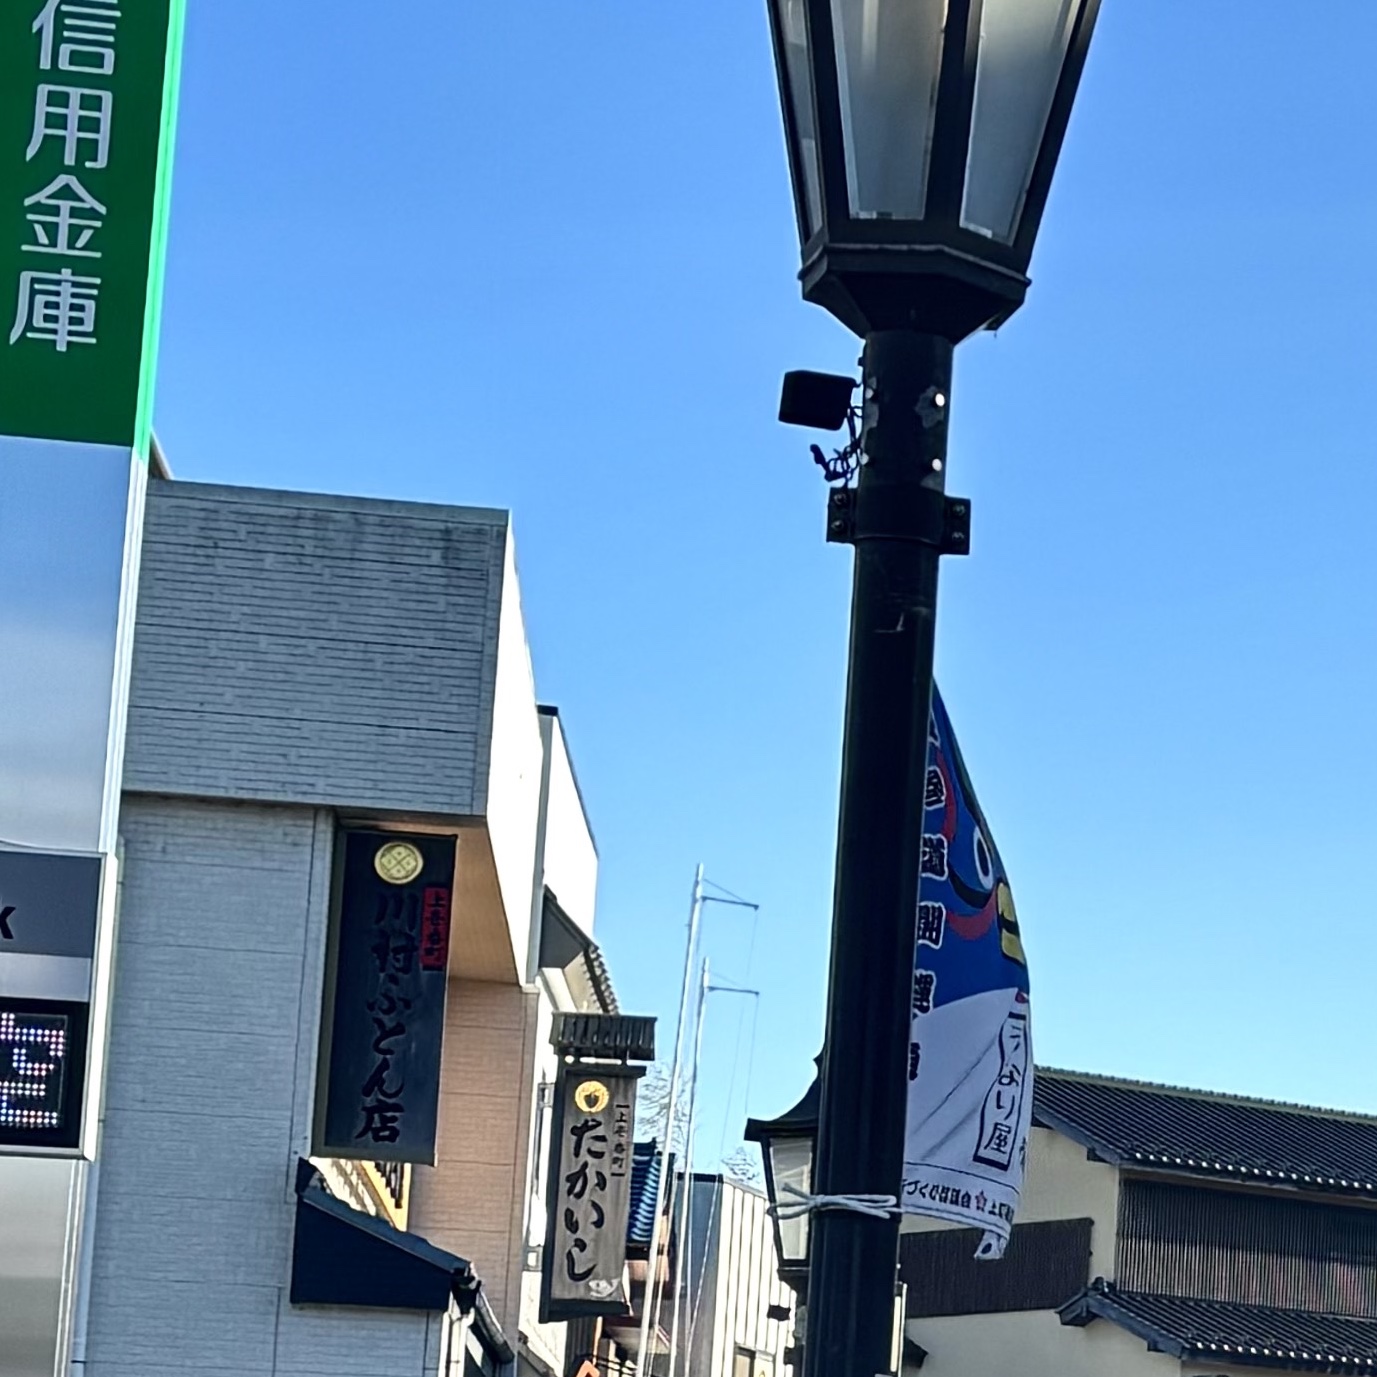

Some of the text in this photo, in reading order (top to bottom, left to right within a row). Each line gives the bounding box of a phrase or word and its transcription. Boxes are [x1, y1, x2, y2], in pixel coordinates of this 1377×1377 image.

[10, 0, 122, 352] 信用金庫
[355, 892, 420, 1143] 川村ふとん店
[564, 1117, 608, 1282] たかいし
